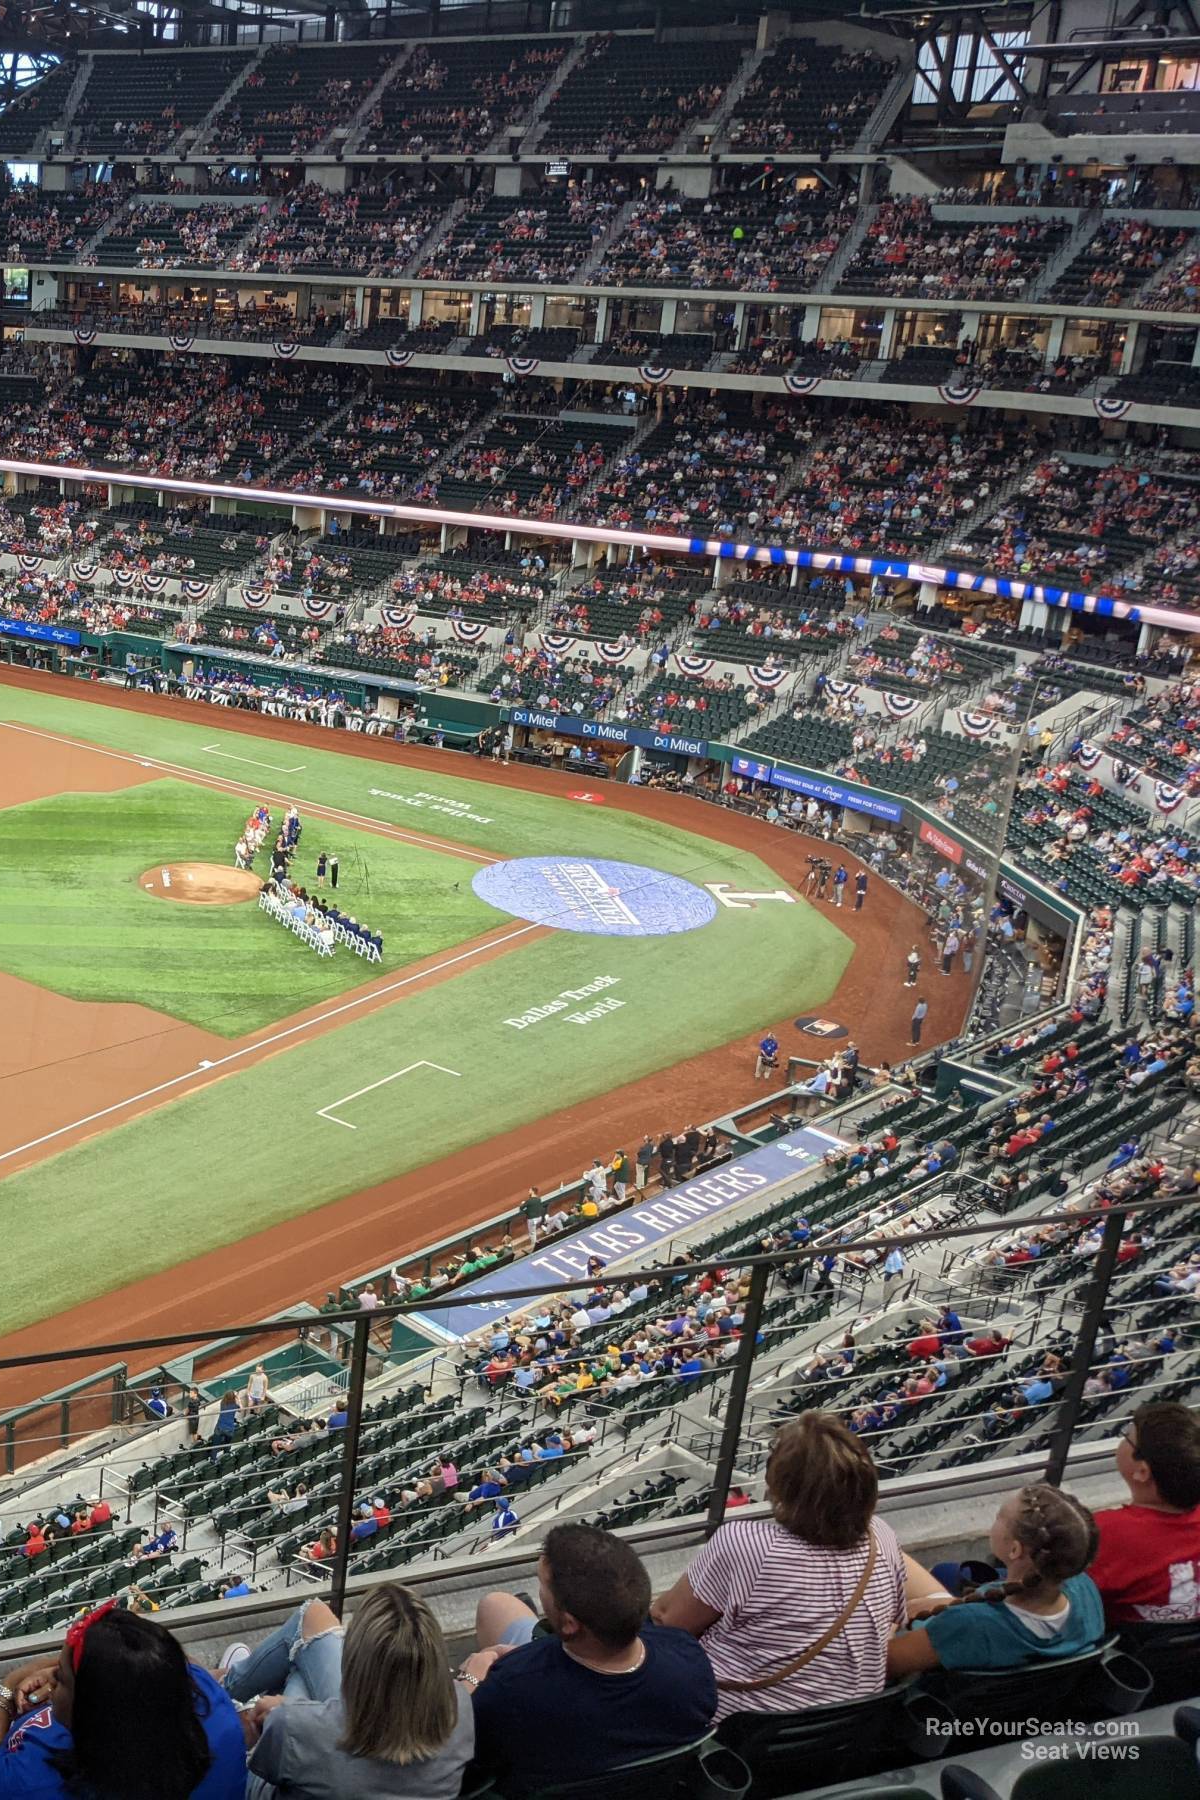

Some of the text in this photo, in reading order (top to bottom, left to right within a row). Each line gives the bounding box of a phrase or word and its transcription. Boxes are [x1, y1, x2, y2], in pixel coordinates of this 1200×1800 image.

[528, 713, 557, 729] Mitel
[597, 726, 627, 741] Mitel
[670, 738, 701, 754] Mitel
[414, 791, 472, 810] World
[814, 785, 821, 793] AT
[822, 785, 843, 801] Kroger
[367, 788, 496, 824] Dallas Truck
[703, 882, 797, 909] T
[501, 975, 622, 1030] Dallas Truck
[561, 997, 627, 1025] World
[531, 1165, 768, 1280] TEXAS RANGERS
